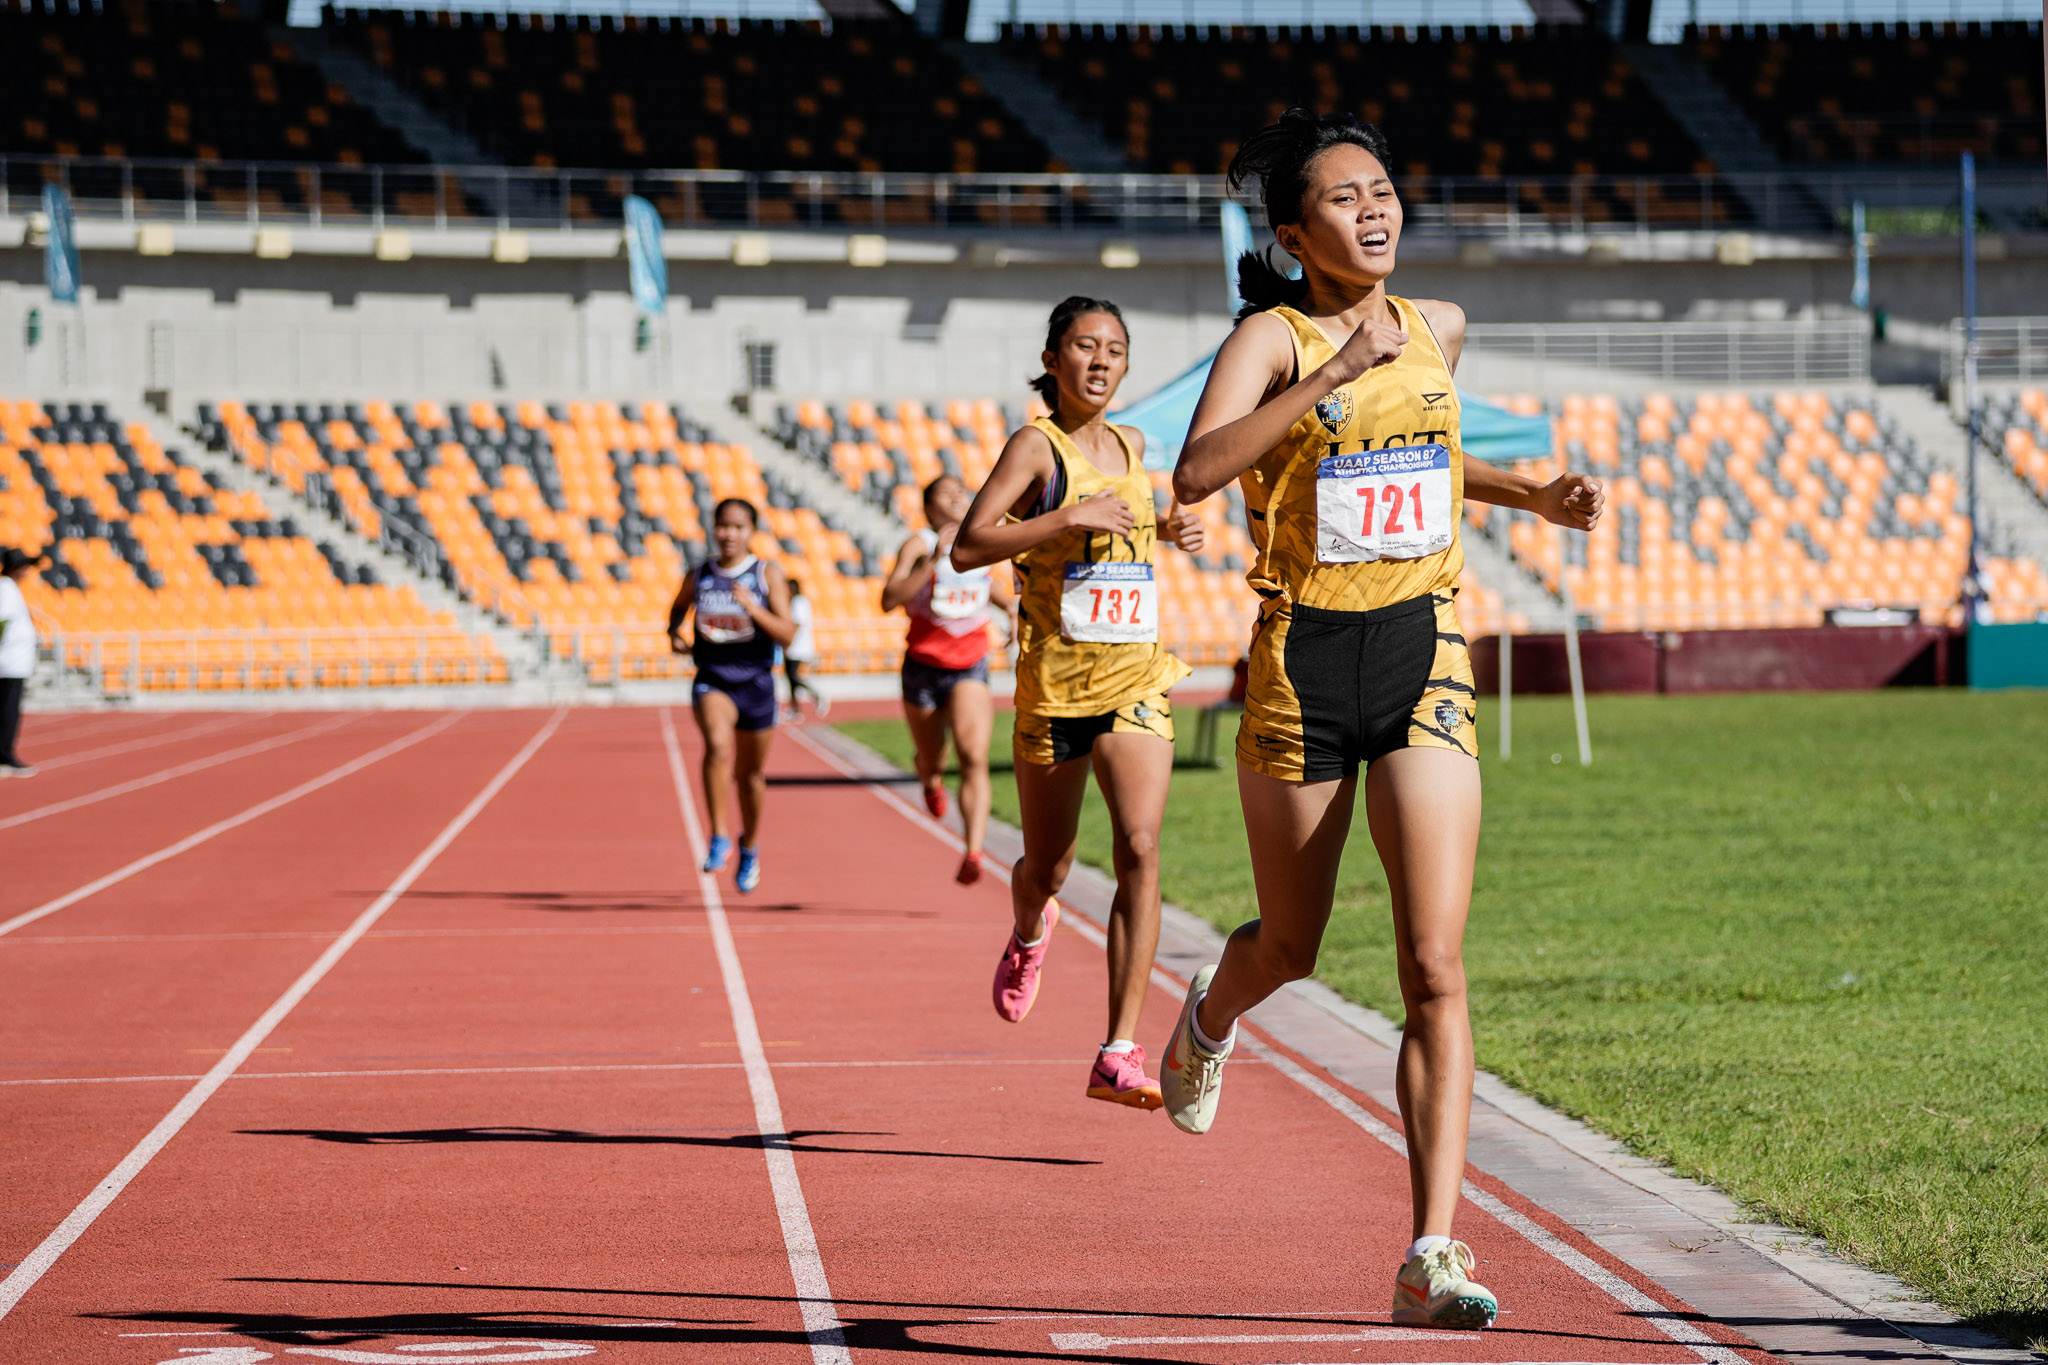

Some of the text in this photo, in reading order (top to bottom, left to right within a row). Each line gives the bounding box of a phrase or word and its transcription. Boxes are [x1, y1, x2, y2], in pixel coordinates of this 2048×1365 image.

[1334, 449, 1436, 469] UAAP SEASON 87
[1335, 460, 1434, 476] ATHLETICS CHAMPIONSHIPS
[1356, 482, 1425, 536] 721
[1106, 565, 1141, 575] SEASON
[1089, 588, 1141, 624] 732
